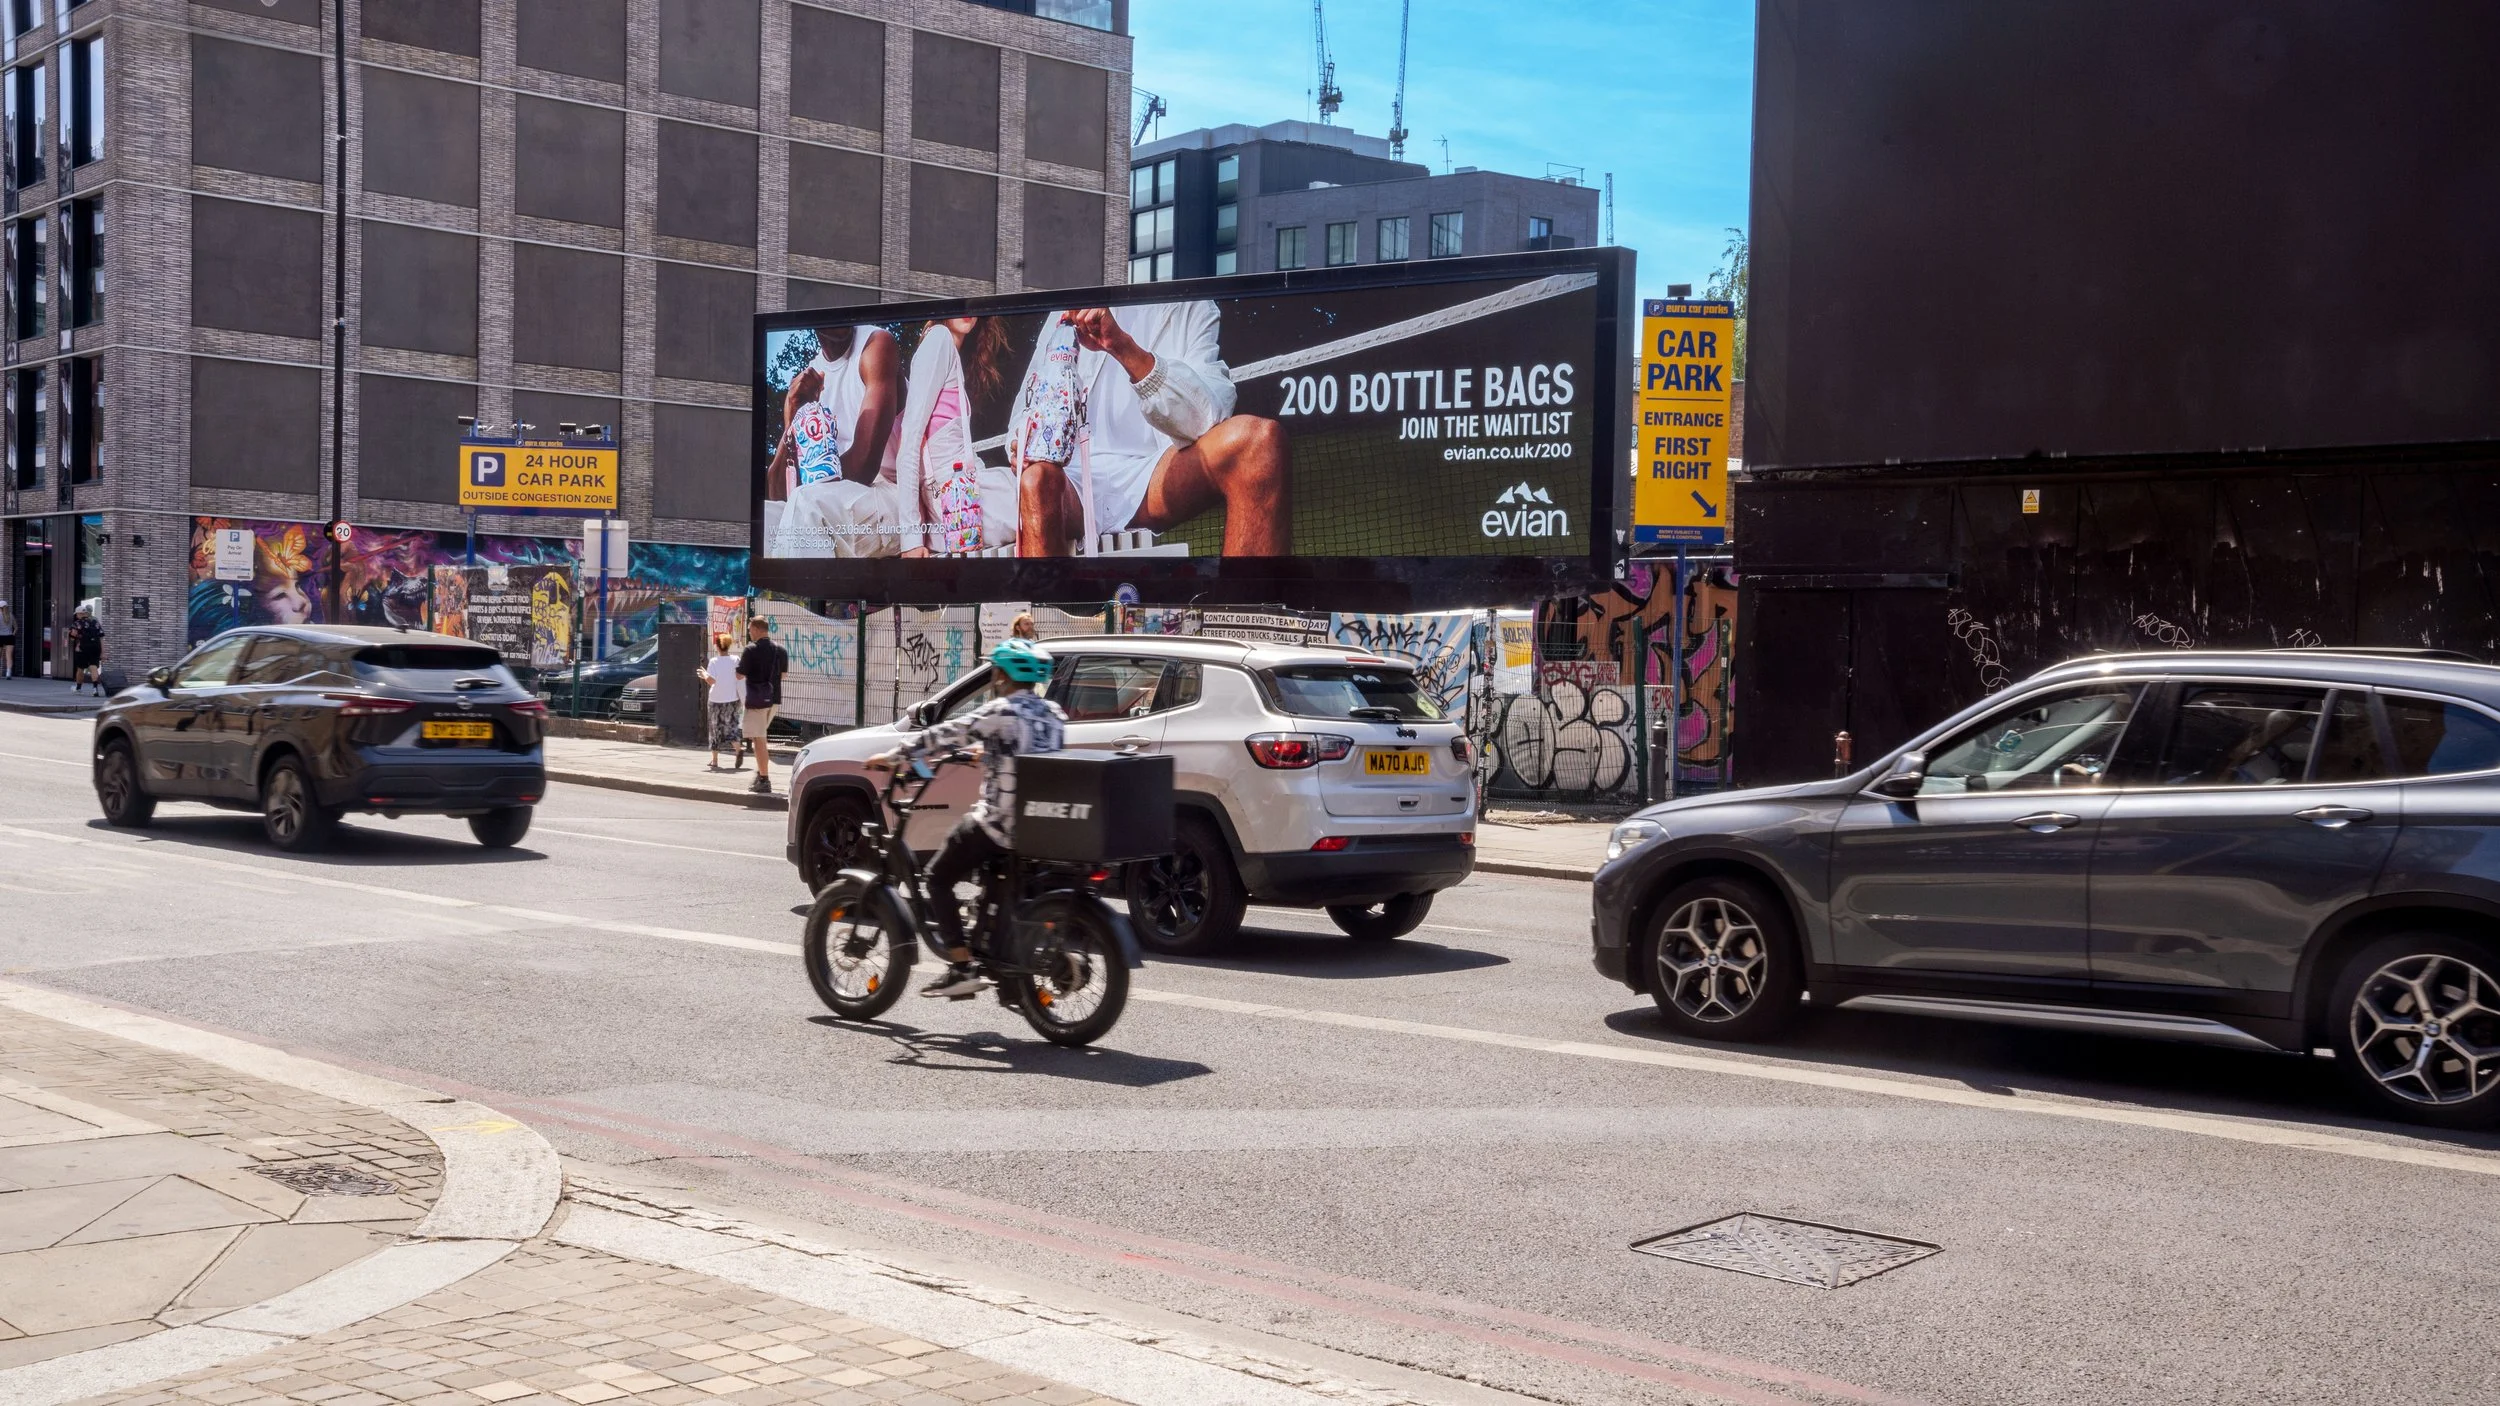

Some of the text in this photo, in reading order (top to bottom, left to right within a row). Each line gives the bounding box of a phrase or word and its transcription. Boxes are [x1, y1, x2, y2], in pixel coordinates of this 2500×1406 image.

[1666, 304, 1728, 315] euro car parks
[1657, 329, 1717, 358] CAR
[1050, 351, 1073, 363] evian
[1647, 363, 1723, 392] PARK
[1279, 362, 1574, 416] 200 BOTTLE BAGS
[1399, 411, 1573, 440] JOIN THE WAITLIST
[1644, 411, 1723, 427] ENTRANCE
[1443, 443, 1572, 461] evian.co.uk/200
[1655, 437, 1711, 456] FIRST
[477, 456, 499, 482] P
[526, 455, 598, 469] 24 HOUR
[1652, 461, 1711, 480] RIGHT
[518, 472, 606, 488] CAR PARK
[462, 490, 613, 504] OUTSIDE CONGESTION ZONE
[805, 526, 834, 536] opens
[1204, 614, 1328, 630] CONTACT OUR EVENTS TEAM TODAY!
[1203, 629, 1226, 637] STREET
[1228, 630, 1246, 638] FOOD
[1247, 631, 1271, 640] TRUCKS,
[1370, 754, 1400, 771] MA70
